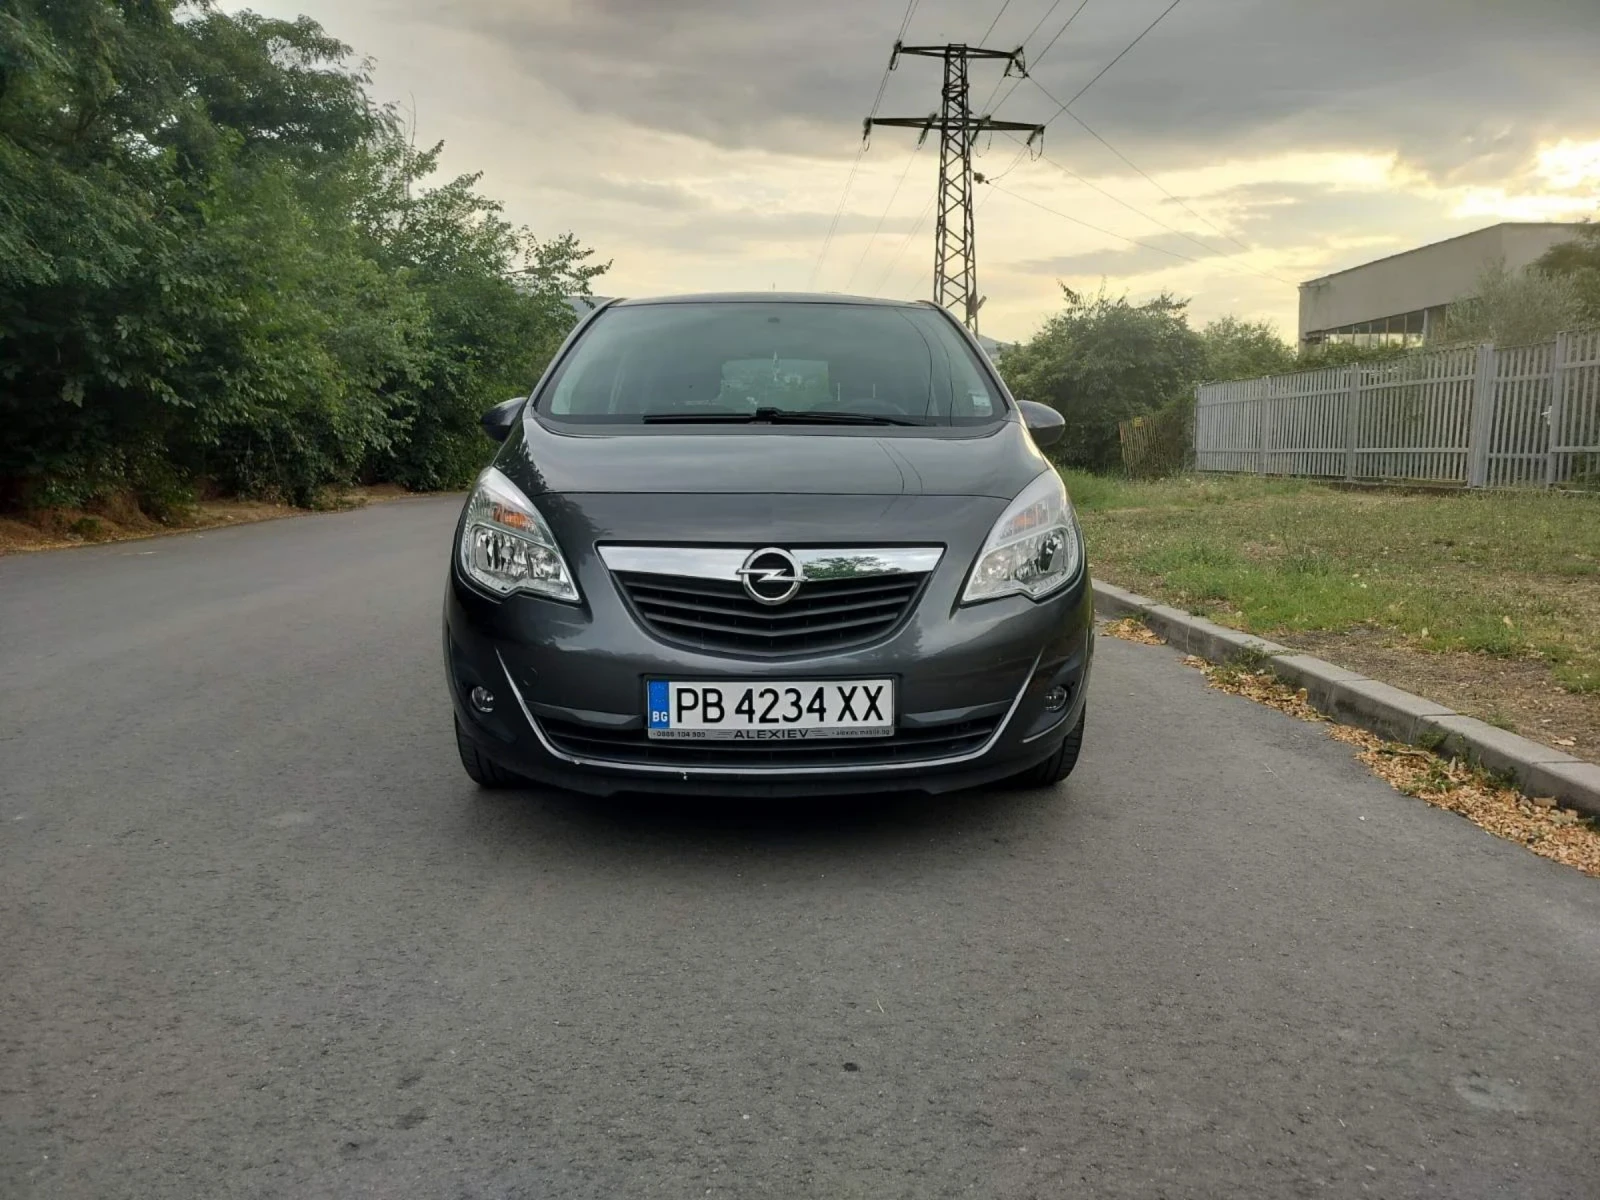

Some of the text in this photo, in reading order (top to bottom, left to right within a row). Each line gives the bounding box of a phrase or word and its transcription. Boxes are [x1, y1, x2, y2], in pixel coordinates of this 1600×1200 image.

[676, 686, 884, 723] PB 4234 XX
[652, 711, 668, 722] BG
[734, 729, 809, 739] ALEXIEV
